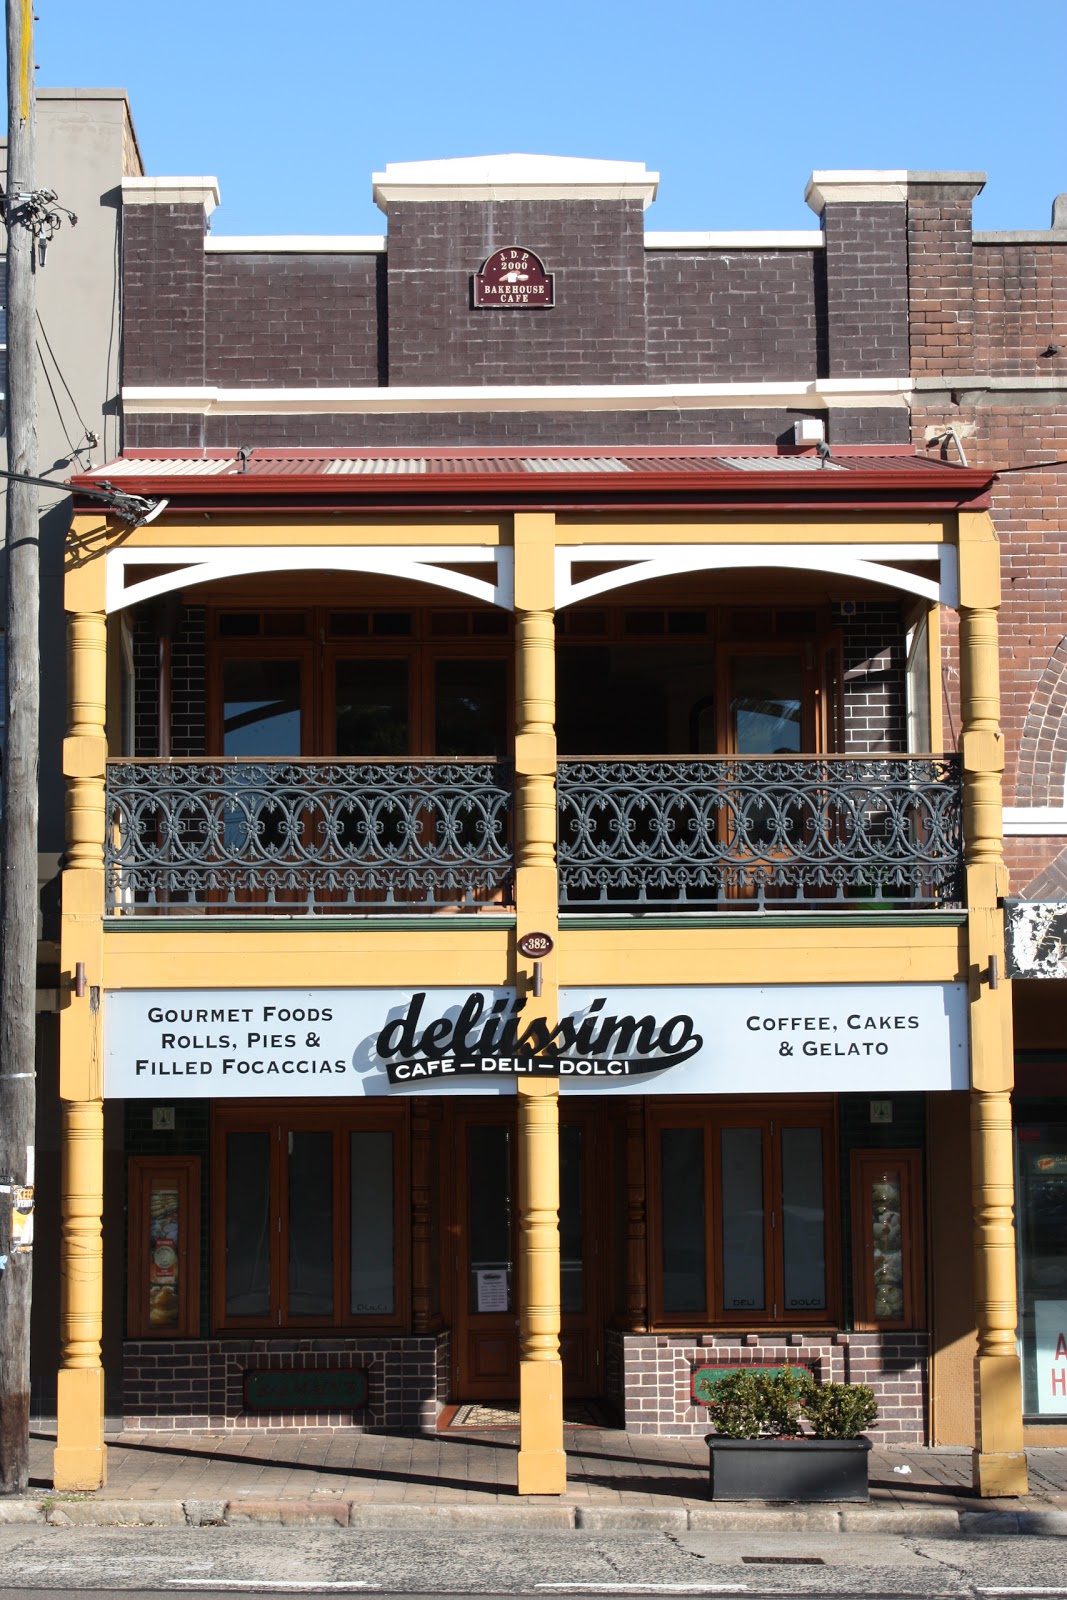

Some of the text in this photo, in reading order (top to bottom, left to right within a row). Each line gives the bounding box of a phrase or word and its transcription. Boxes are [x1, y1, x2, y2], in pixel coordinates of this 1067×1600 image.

[501, 262, 528, 270] 2000
[484, 285, 545, 294] BAKEHOUSE
[500, 294, 529, 303] CAFE
[528, 938, 547, 949] 382
[305, 1031, 321, 1048] &
[778, 1041, 794, 1056] &
[394, 1058, 456, 1079] CAFE
[481, 1057, 533, 1072] DELI
[559, 1060, 629, 1075] DOLCI
